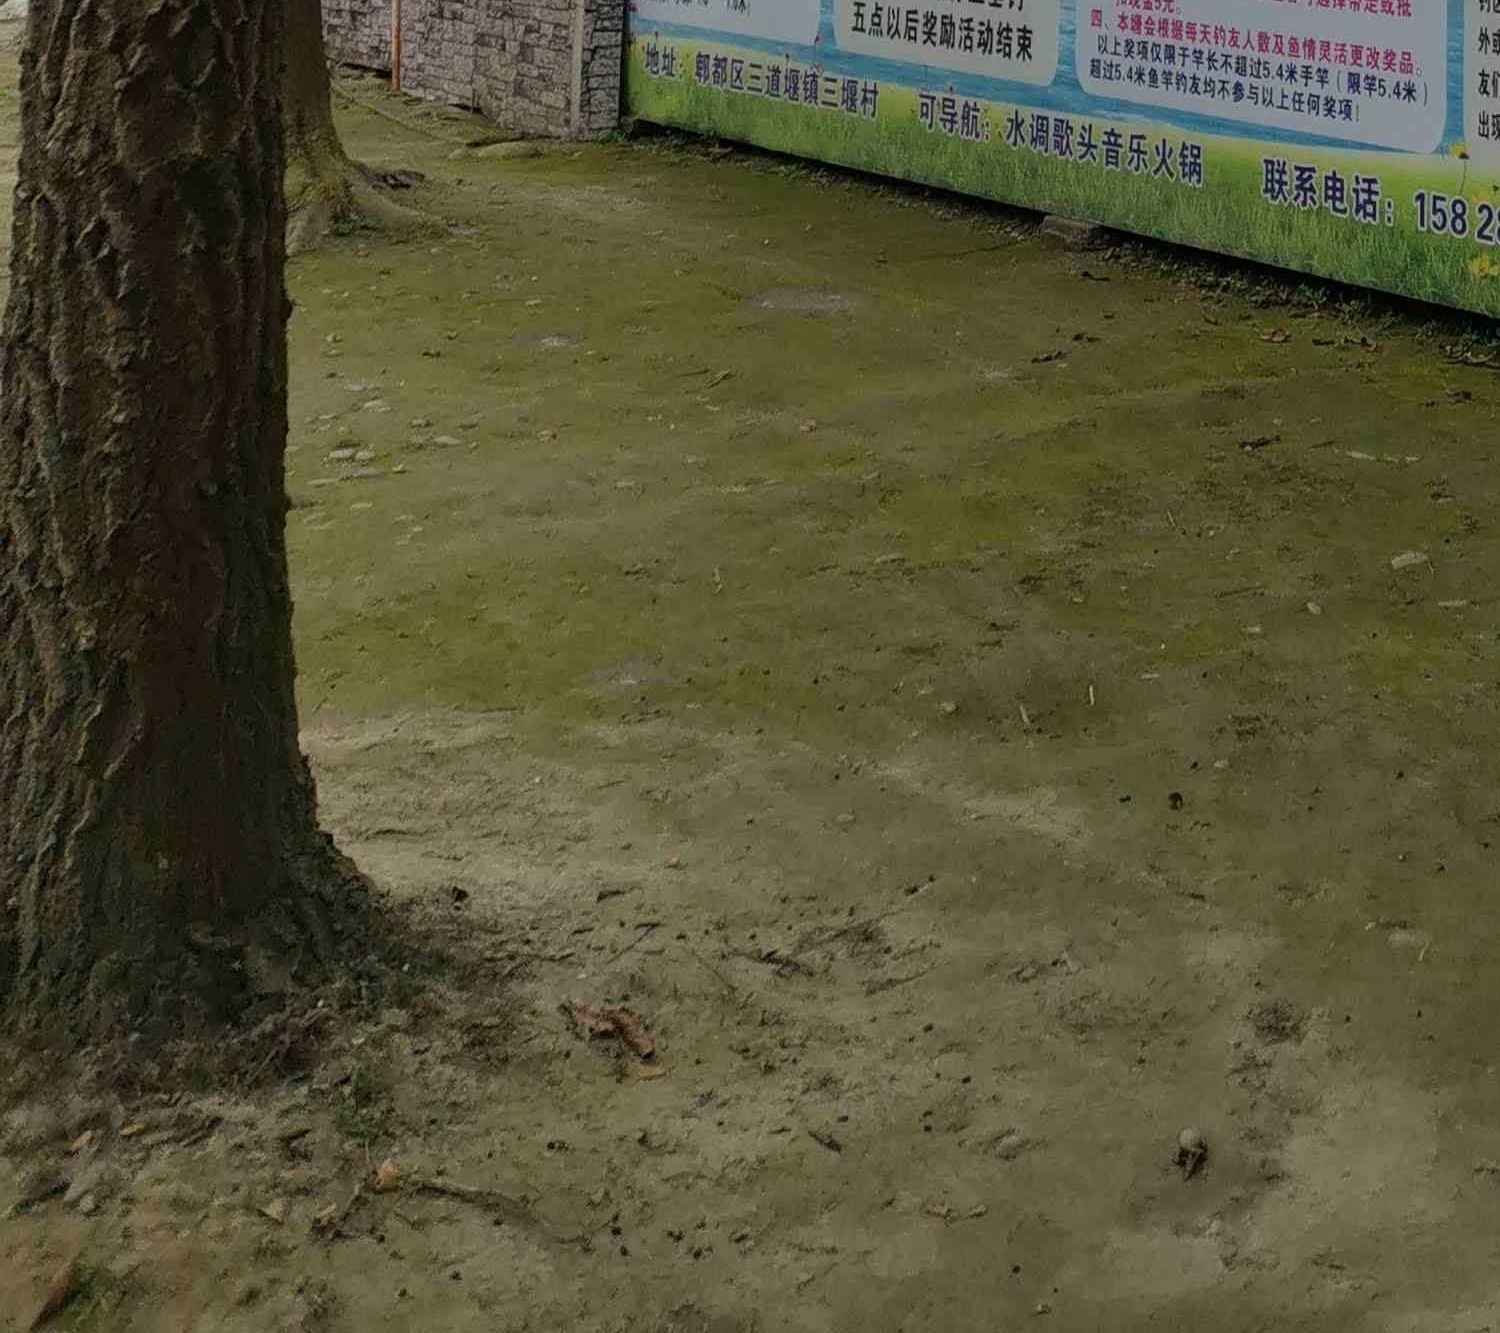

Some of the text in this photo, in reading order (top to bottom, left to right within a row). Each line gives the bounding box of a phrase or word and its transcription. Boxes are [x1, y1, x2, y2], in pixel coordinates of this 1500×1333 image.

[851, 0, 1034, 63] 五点以后奖励活动结束
